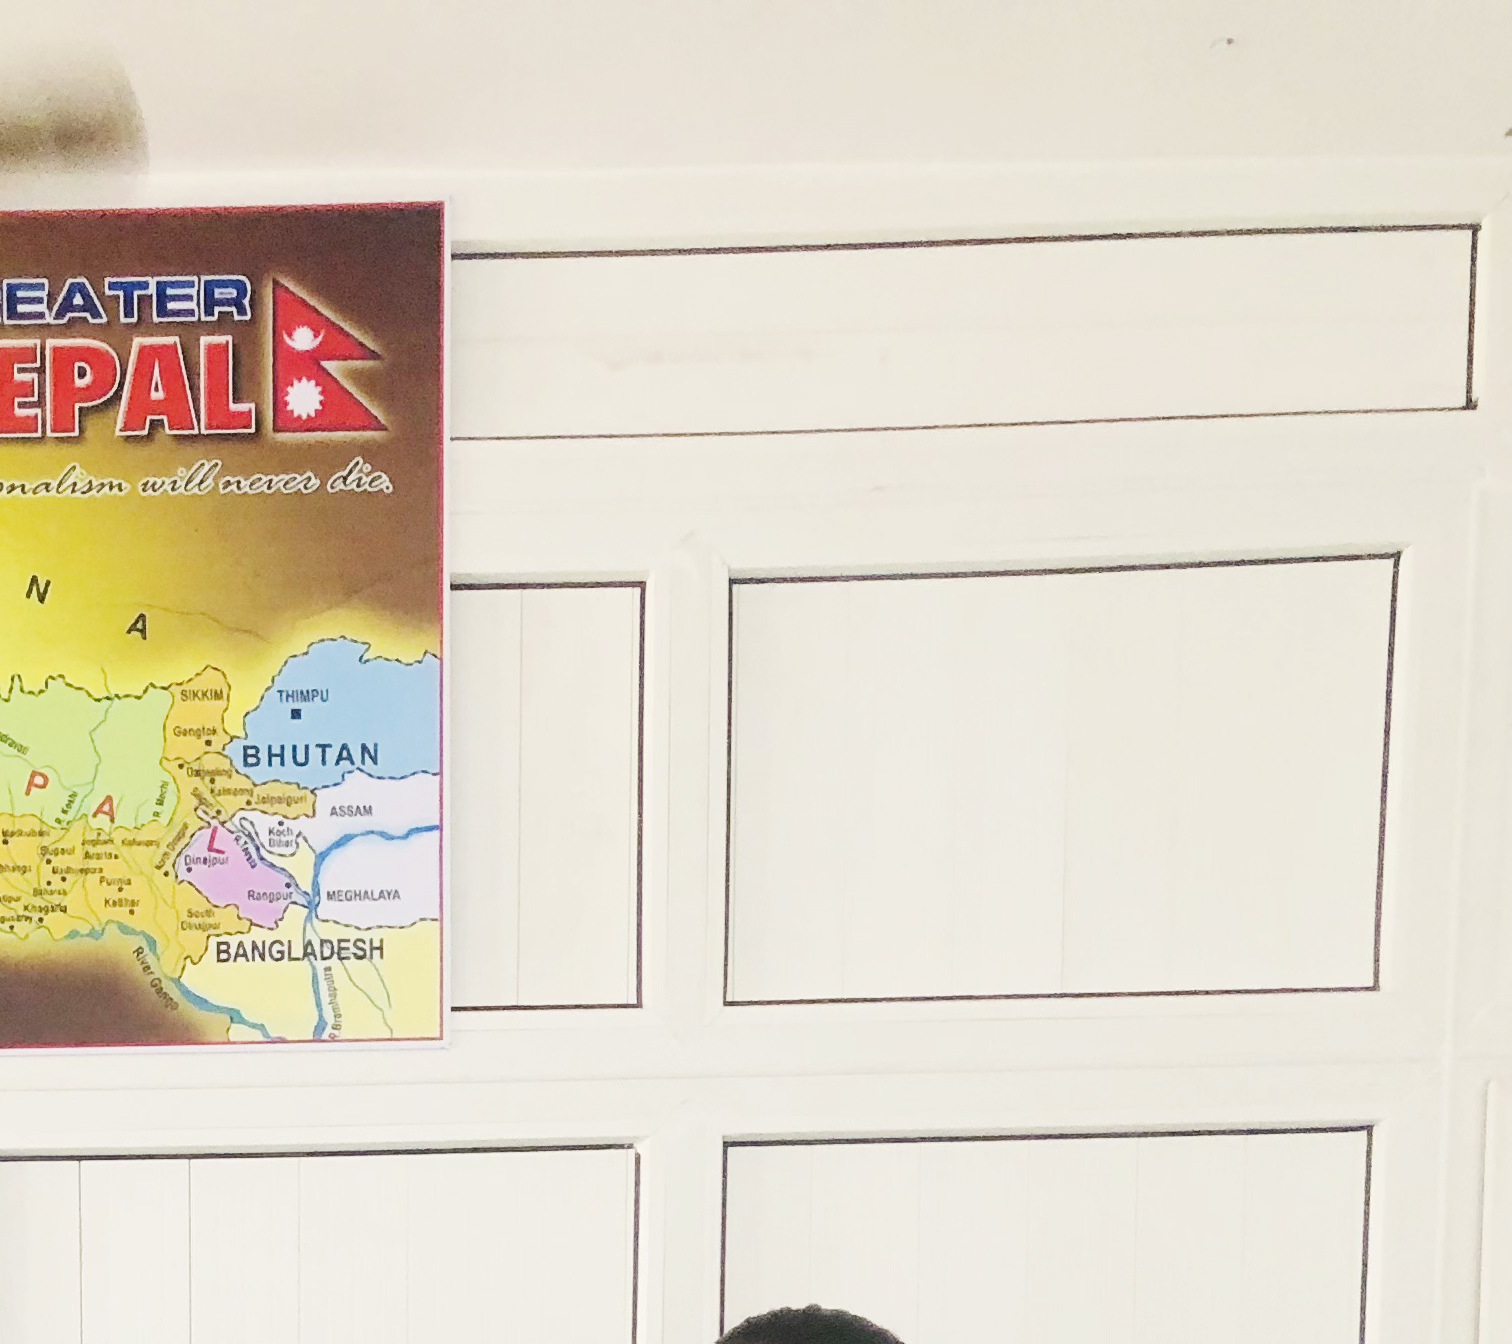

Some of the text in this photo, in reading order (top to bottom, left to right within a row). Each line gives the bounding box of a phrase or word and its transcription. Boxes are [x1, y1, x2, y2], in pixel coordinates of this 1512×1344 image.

[139, 458, 222, 496] will
[220, 469, 320, 495] never
[325, 456, 394, 495] die.
[180, 689, 225, 703] SIKKIM
[277, 688, 329, 703] THIMPU
[242, 742, 379, 768] BHUTAN
[330, 804, 373, 817] ASSAM
[268, 826, 294, 838] Koch
[184, 854, 230, 869] Dinajpur
[247, 889, 295, 904] Rangpur
[326, 889, 402, 902] MEGHALAYA
[216, 938, 385, 964] BANGLADESH
